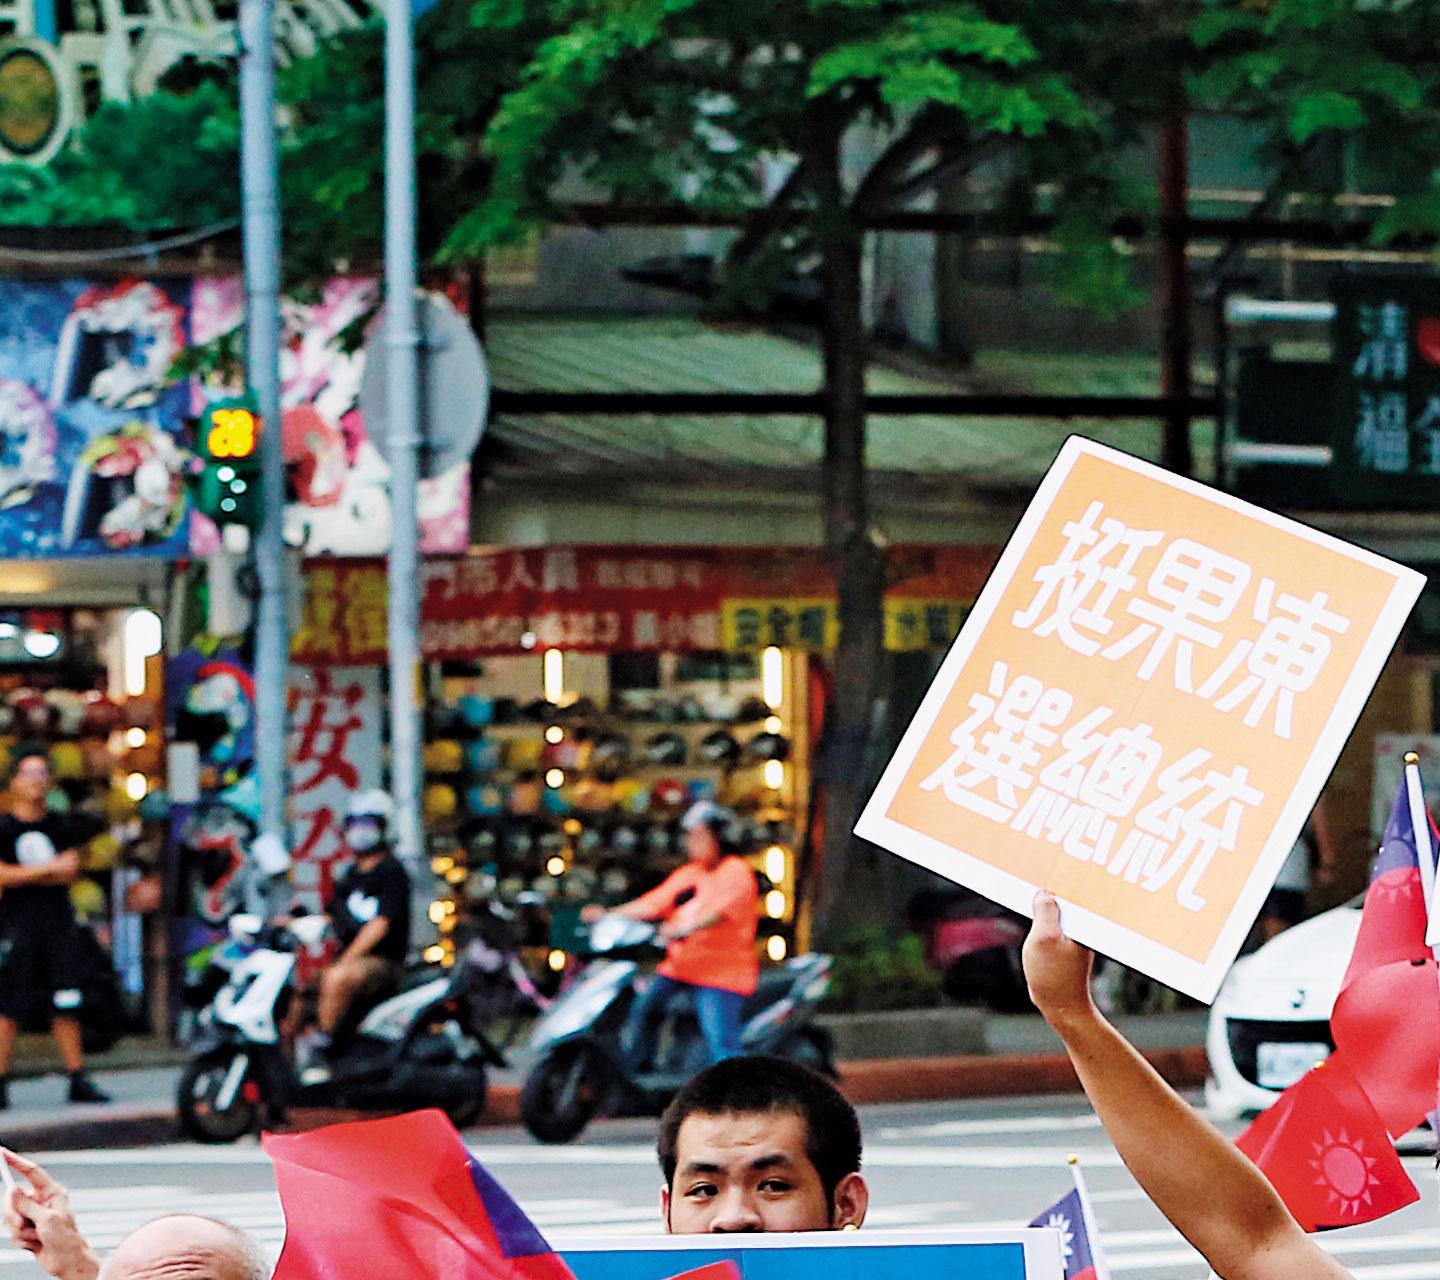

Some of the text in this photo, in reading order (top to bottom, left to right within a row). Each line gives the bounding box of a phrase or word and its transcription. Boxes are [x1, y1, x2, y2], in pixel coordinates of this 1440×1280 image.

[1011, 500, 1351, 740] 挺果凍
[919, 661, 1265, 913] 選總統
